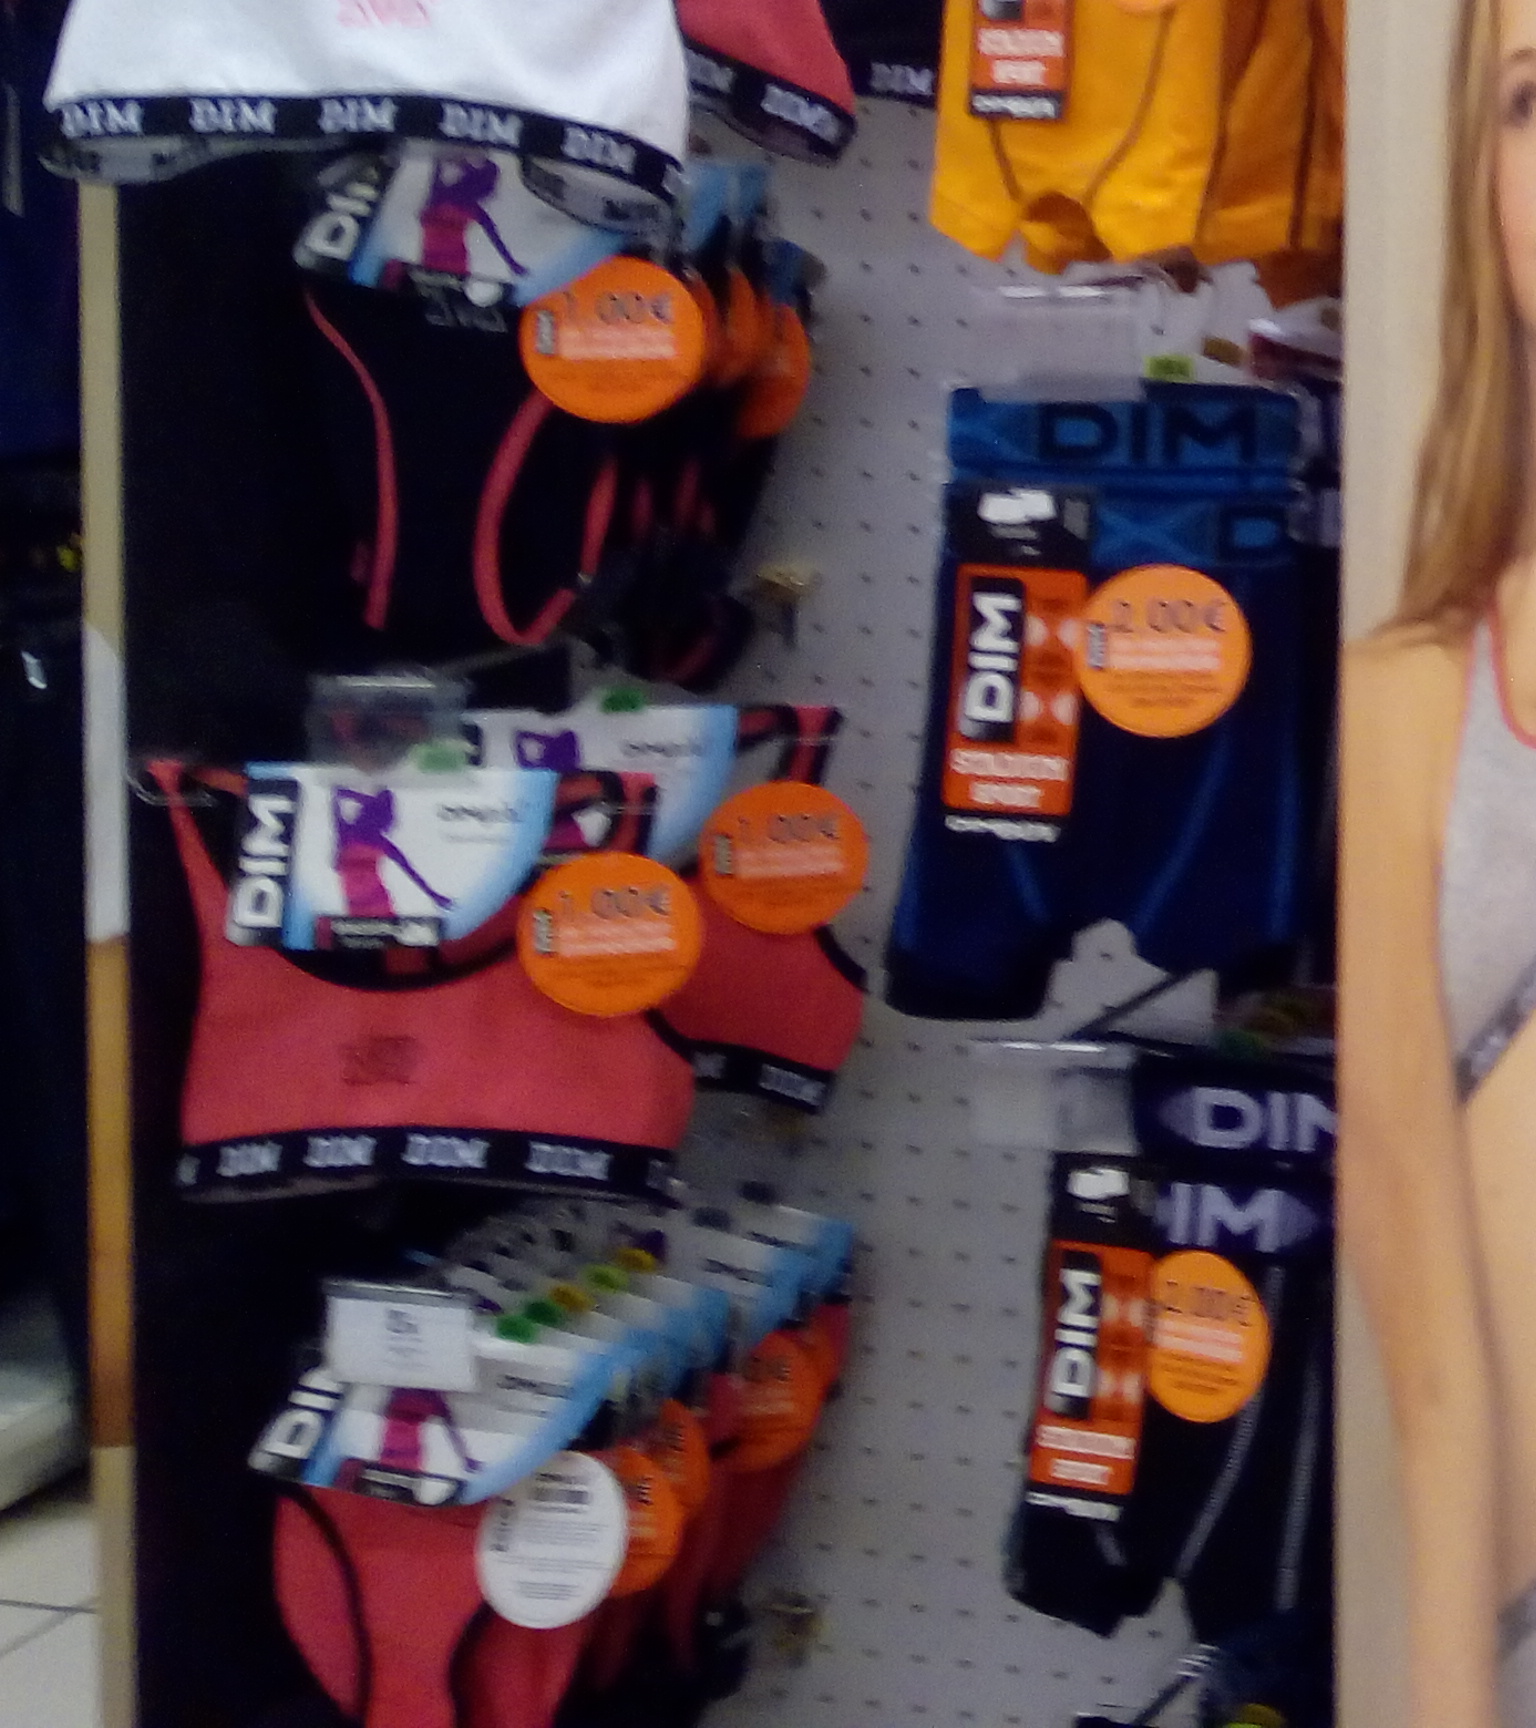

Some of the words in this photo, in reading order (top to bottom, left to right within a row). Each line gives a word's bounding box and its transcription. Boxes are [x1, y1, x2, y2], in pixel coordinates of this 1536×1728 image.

[964, 591, 1023, 723] DIM
[231, 794, 298, 929] DIM
[1168, 1181, 1280, 1253] IM
[1051, 1268, 1100, 1400] DIM
